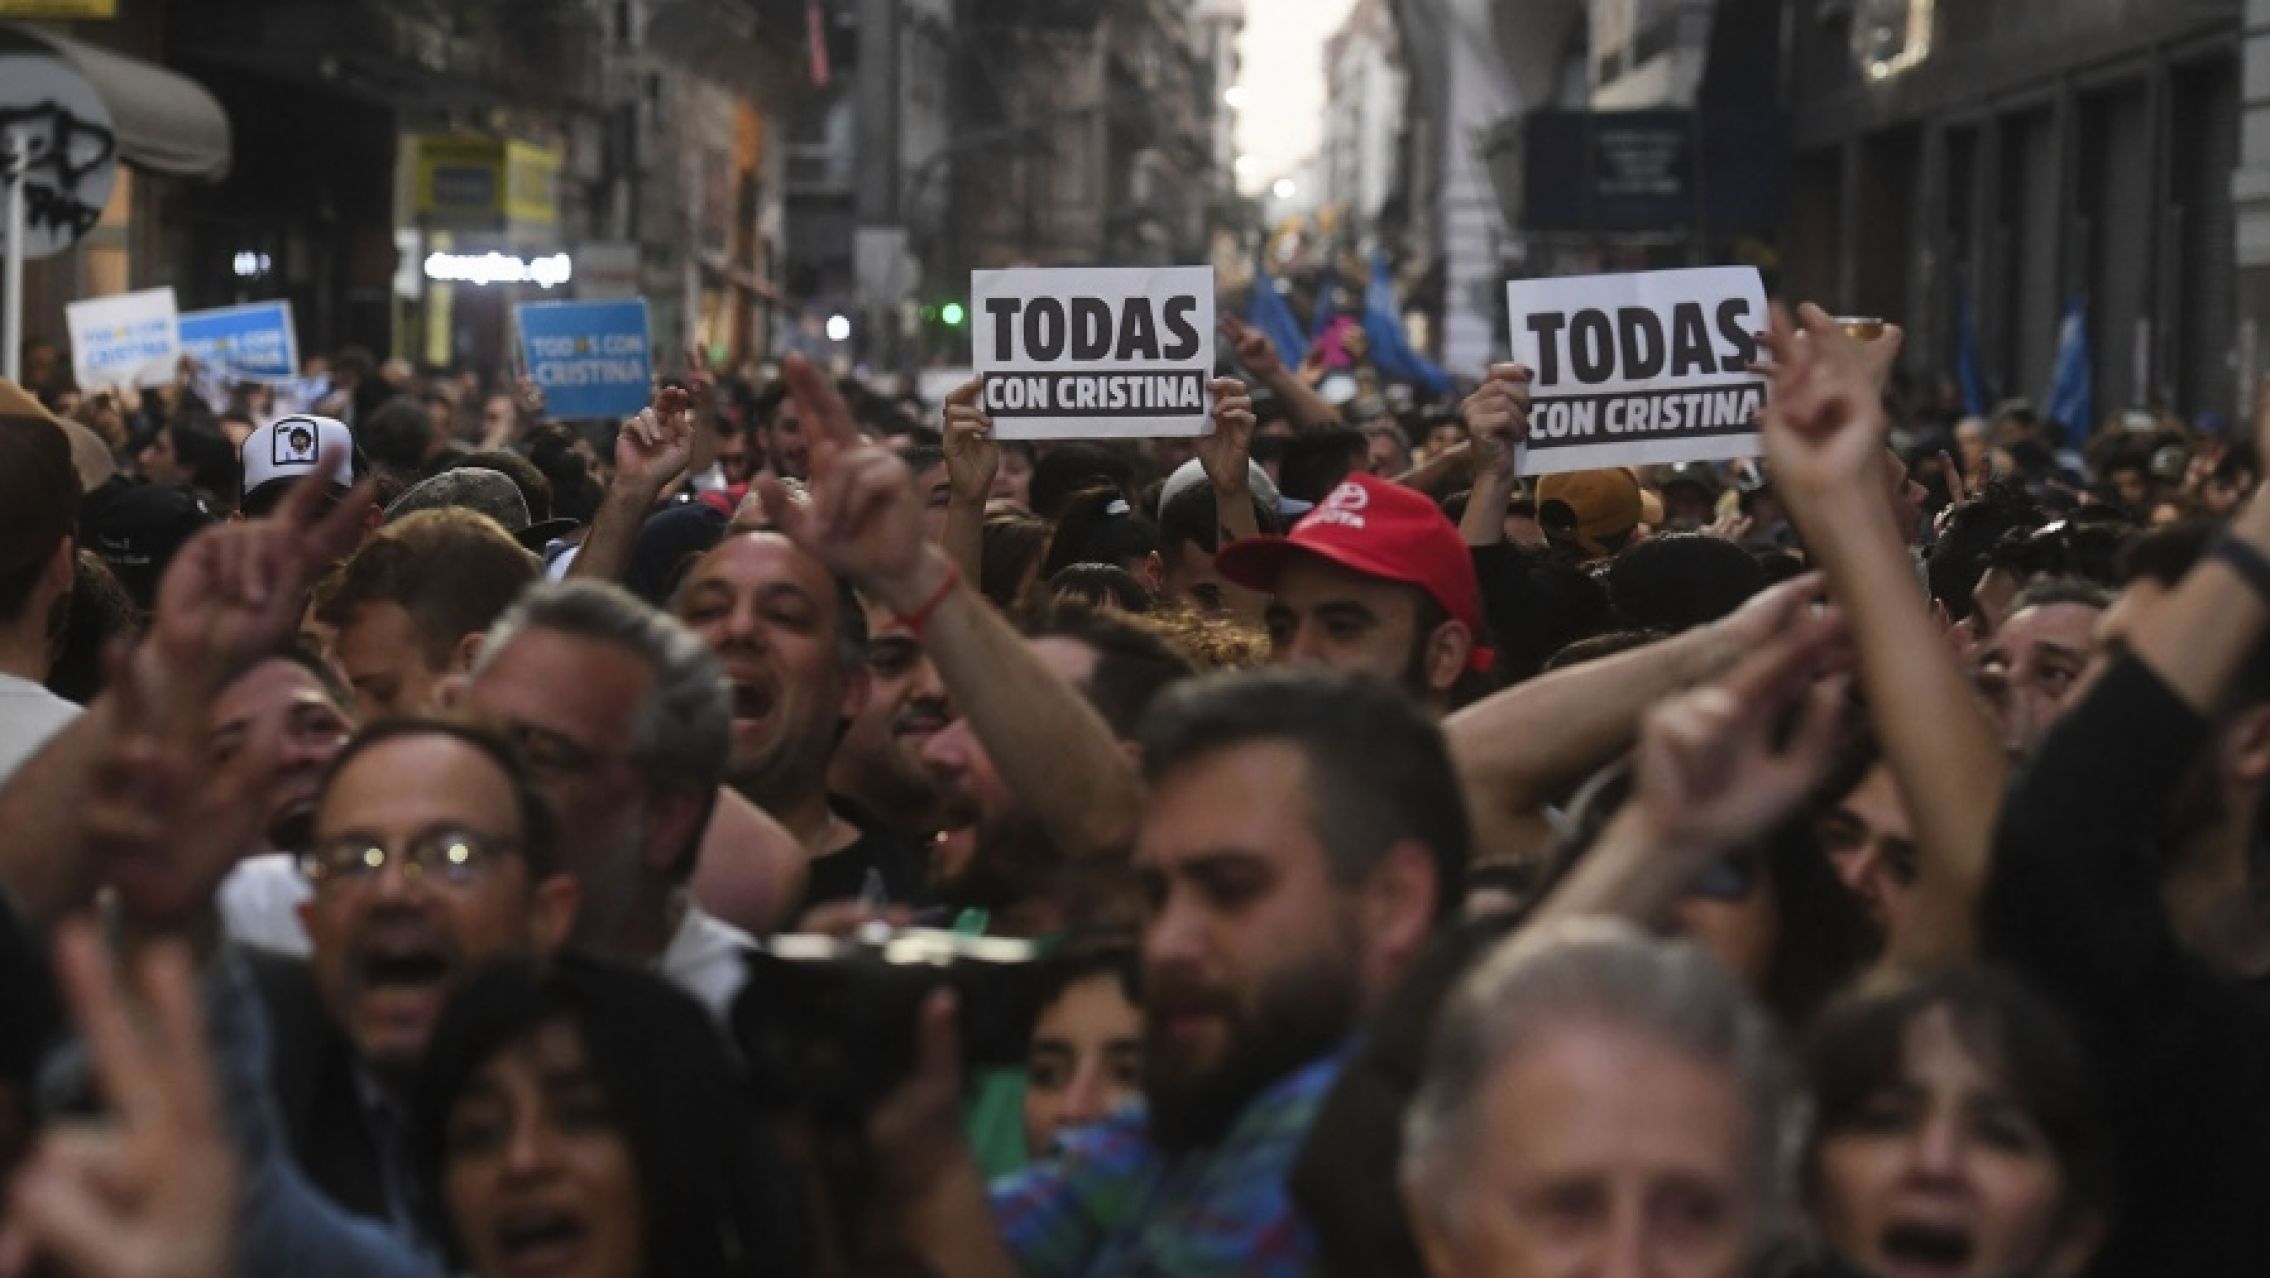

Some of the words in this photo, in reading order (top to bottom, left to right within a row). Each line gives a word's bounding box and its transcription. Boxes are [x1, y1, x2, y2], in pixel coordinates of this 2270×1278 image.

[985, 295, 1200, 362] TODAS
[1526, 298, 1757, 386] TODAS
[535, 358, 644, 386] CRISTINA
[987, 376, 1049, 410] CON
[1056, 375, 1201, 410] CRISTINA
[1527, 400, 1596, 440] CON
[1604, 389, 1760, 434] CRISTINA
